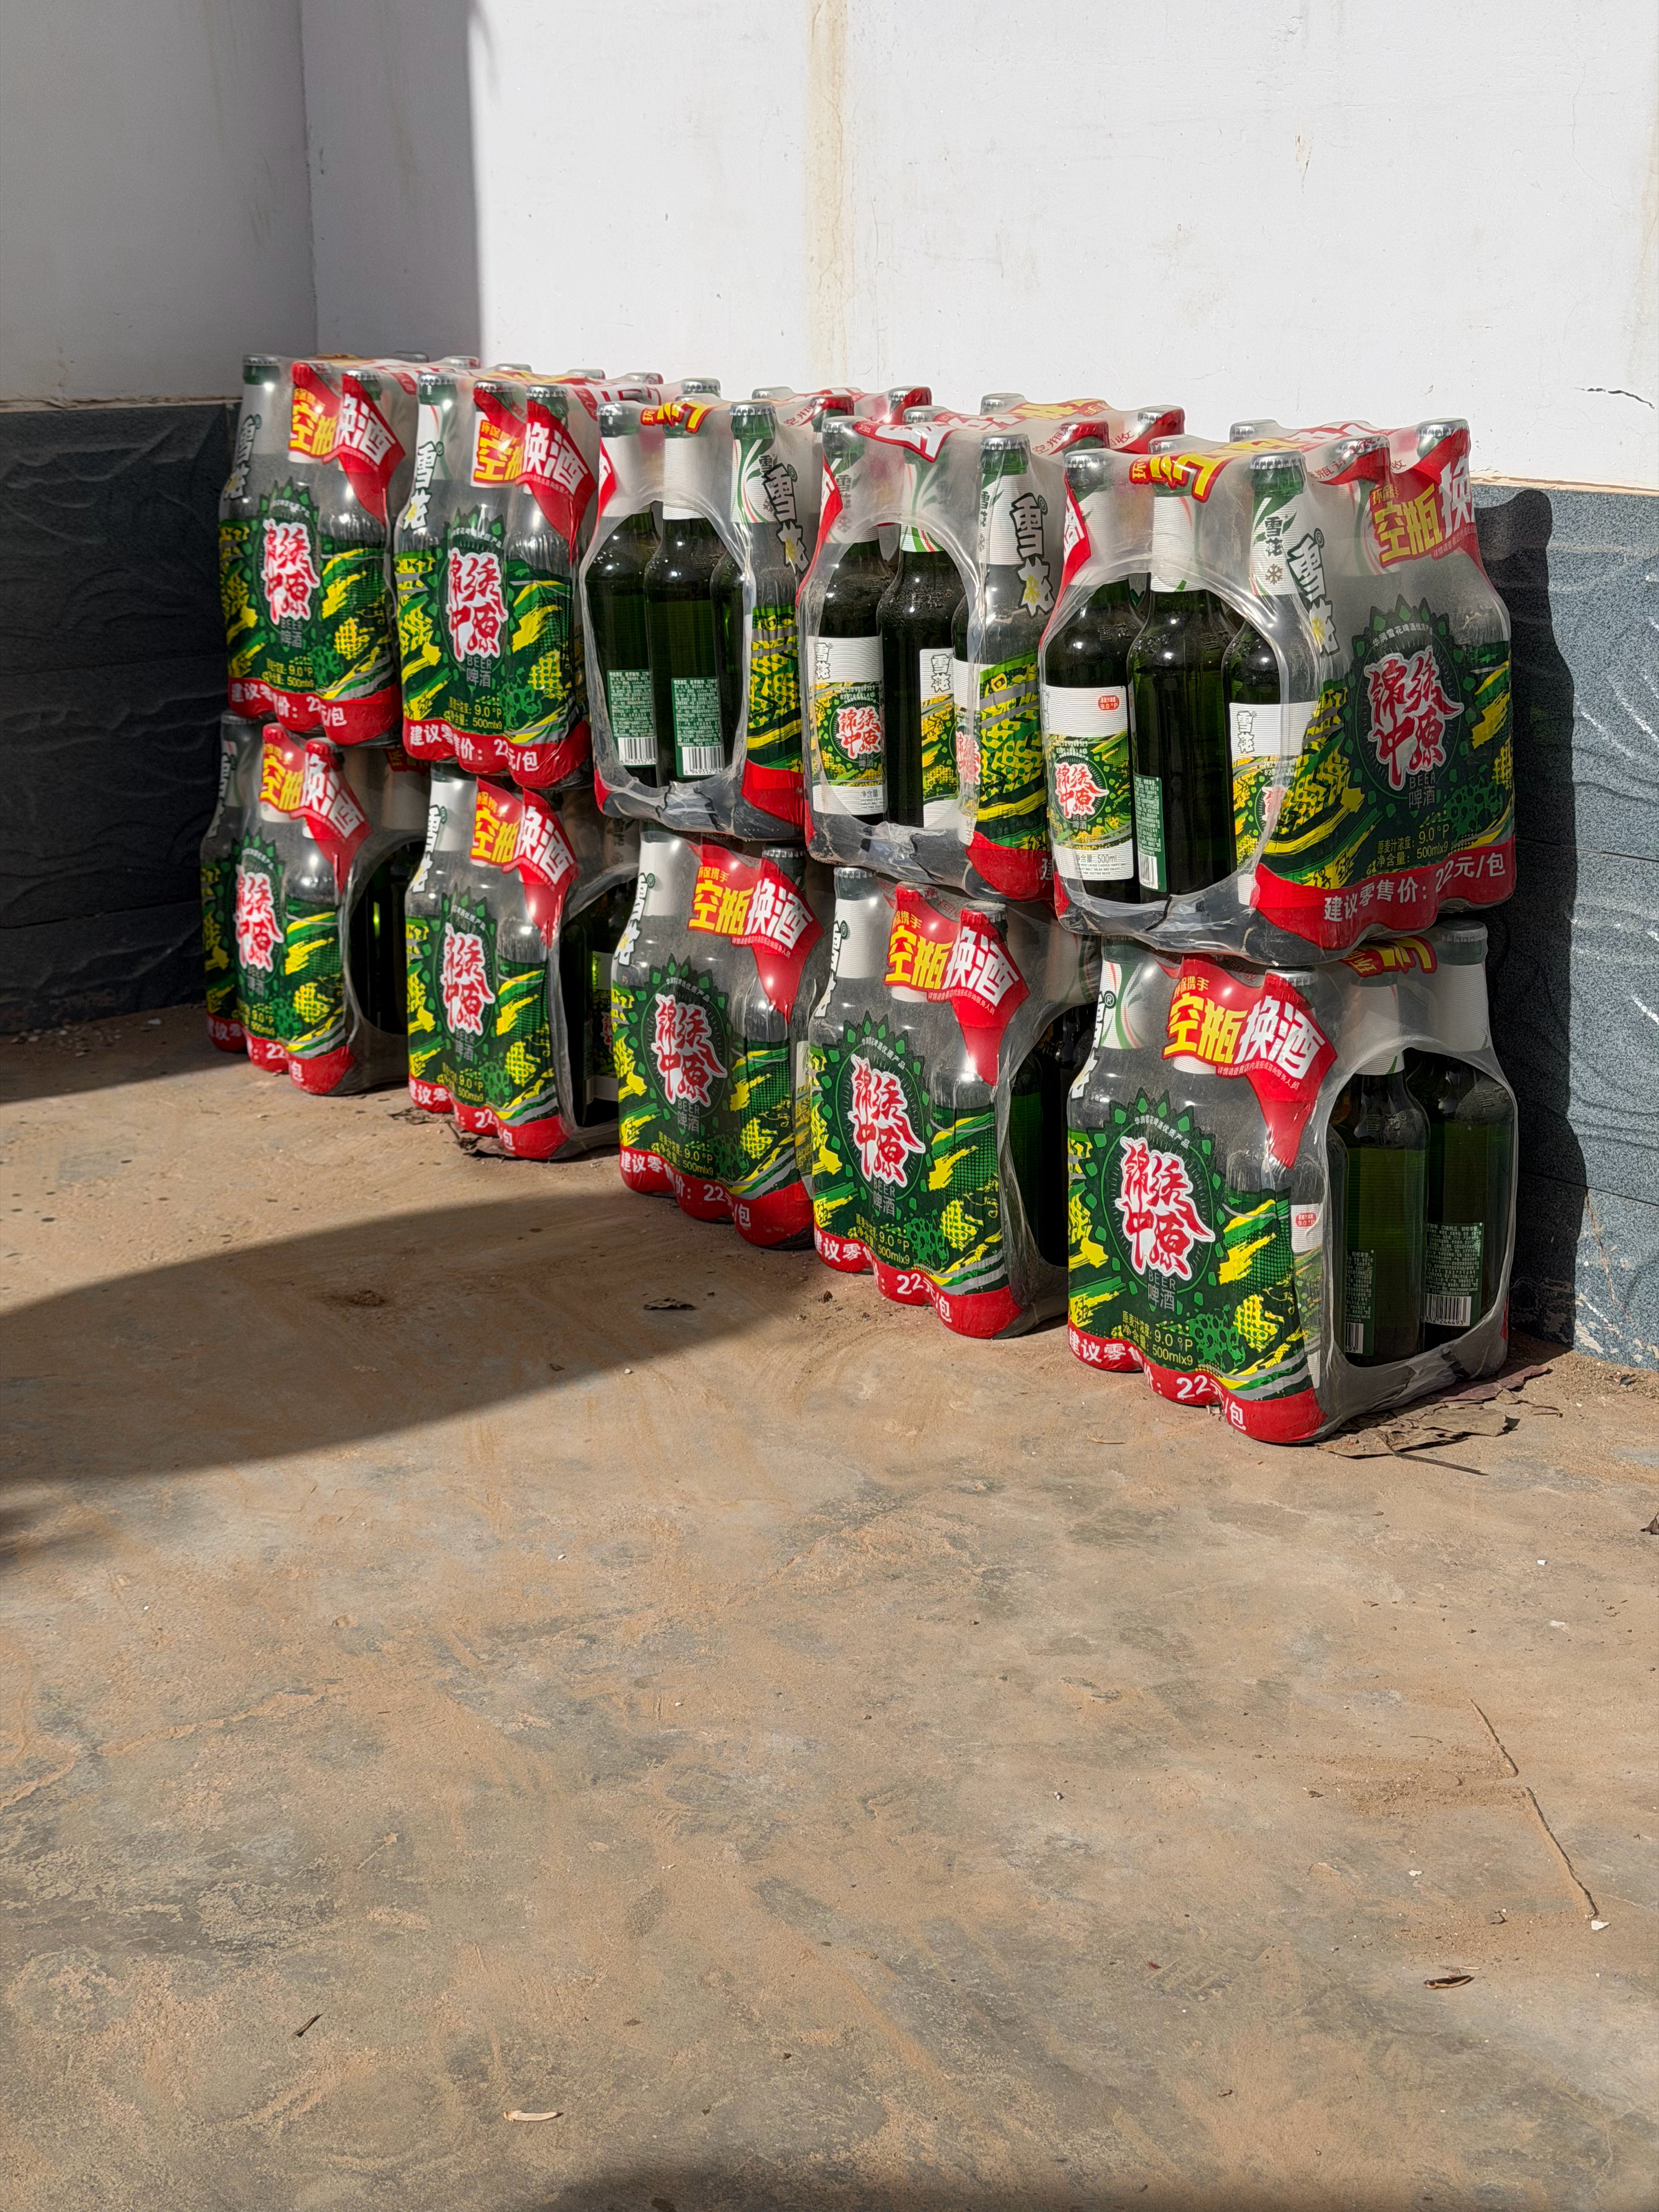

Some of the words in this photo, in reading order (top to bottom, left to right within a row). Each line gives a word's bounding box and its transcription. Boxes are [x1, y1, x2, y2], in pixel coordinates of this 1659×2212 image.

[290, 393, 396, 465] 空瓶换酒
[475, 421, 588, 495] 空瓶换酒
[763, 463, 809, 572] 雪花
[1265, 516, 1285, 557] 雪花
[1010, 493, 1055, 616] 雪花
[1287, 532, 1340, 656] 雪花
[466, 669, 492, 688] 啤酒
[467, 656, 492, 670] BEER
[815, 642, 831, 680] 雪花
[930, 653, 951, 692] 雪花
[231, 681, 347, 727] 建议零价：22元/包
[836, 729, 881, 759] 中原
[1237, 711, 1255, 754] 雪花
[1368, 707, 1448, 791] 中原
[1054, 762, 1109, 798] 锦绣
[1408, 786, 1436, 809] 啤酒
[1409, 772, 1436, 788] BEER
[1056, 788, 1096, 819] 中原
[471, 805, 574, 885] 空瓶换酒
[1376, 851, 1410, 868] 净含量：
[1324, 852, 1506, 922] 建议零售价：22元/包
[689, 878, 814, 951] 空瓶换酒
[885, 926, 1019, 1007] 空瓶换酒
[654, 993, 727, 1077] 锦绣
[1164, 995, 1325, 1080] 空瓶换酒
[651, 1042, 712, 1107] 中原
[677, 1113, 700, 1133] 啤酒
[678, 1099, 700, 1115] BEER
[850, 1053, 925, 1152] 锦绣
[848, 1110, 907, 1187] 中原
[620, 1151, 751, 1228] 建议零价：22/包
[873, 1178, 895, 1196] BEER
[873, 1192, 895, 1217] 啤酒
[1120, 1137, 1215, 1242] 锦绣
[878, 1245, 910, 1265] 500mlx9
[1115, 1198, 1192, 1280] 中原
[1147, 1285, 1175, 1312] 啤酒
[1148, 1271, 1176, 1290] BEER
[1152, 1344, 1193, 1366] 500mlx9
[1069, 1328, 1247, 1430] 建议零价：22元/包
